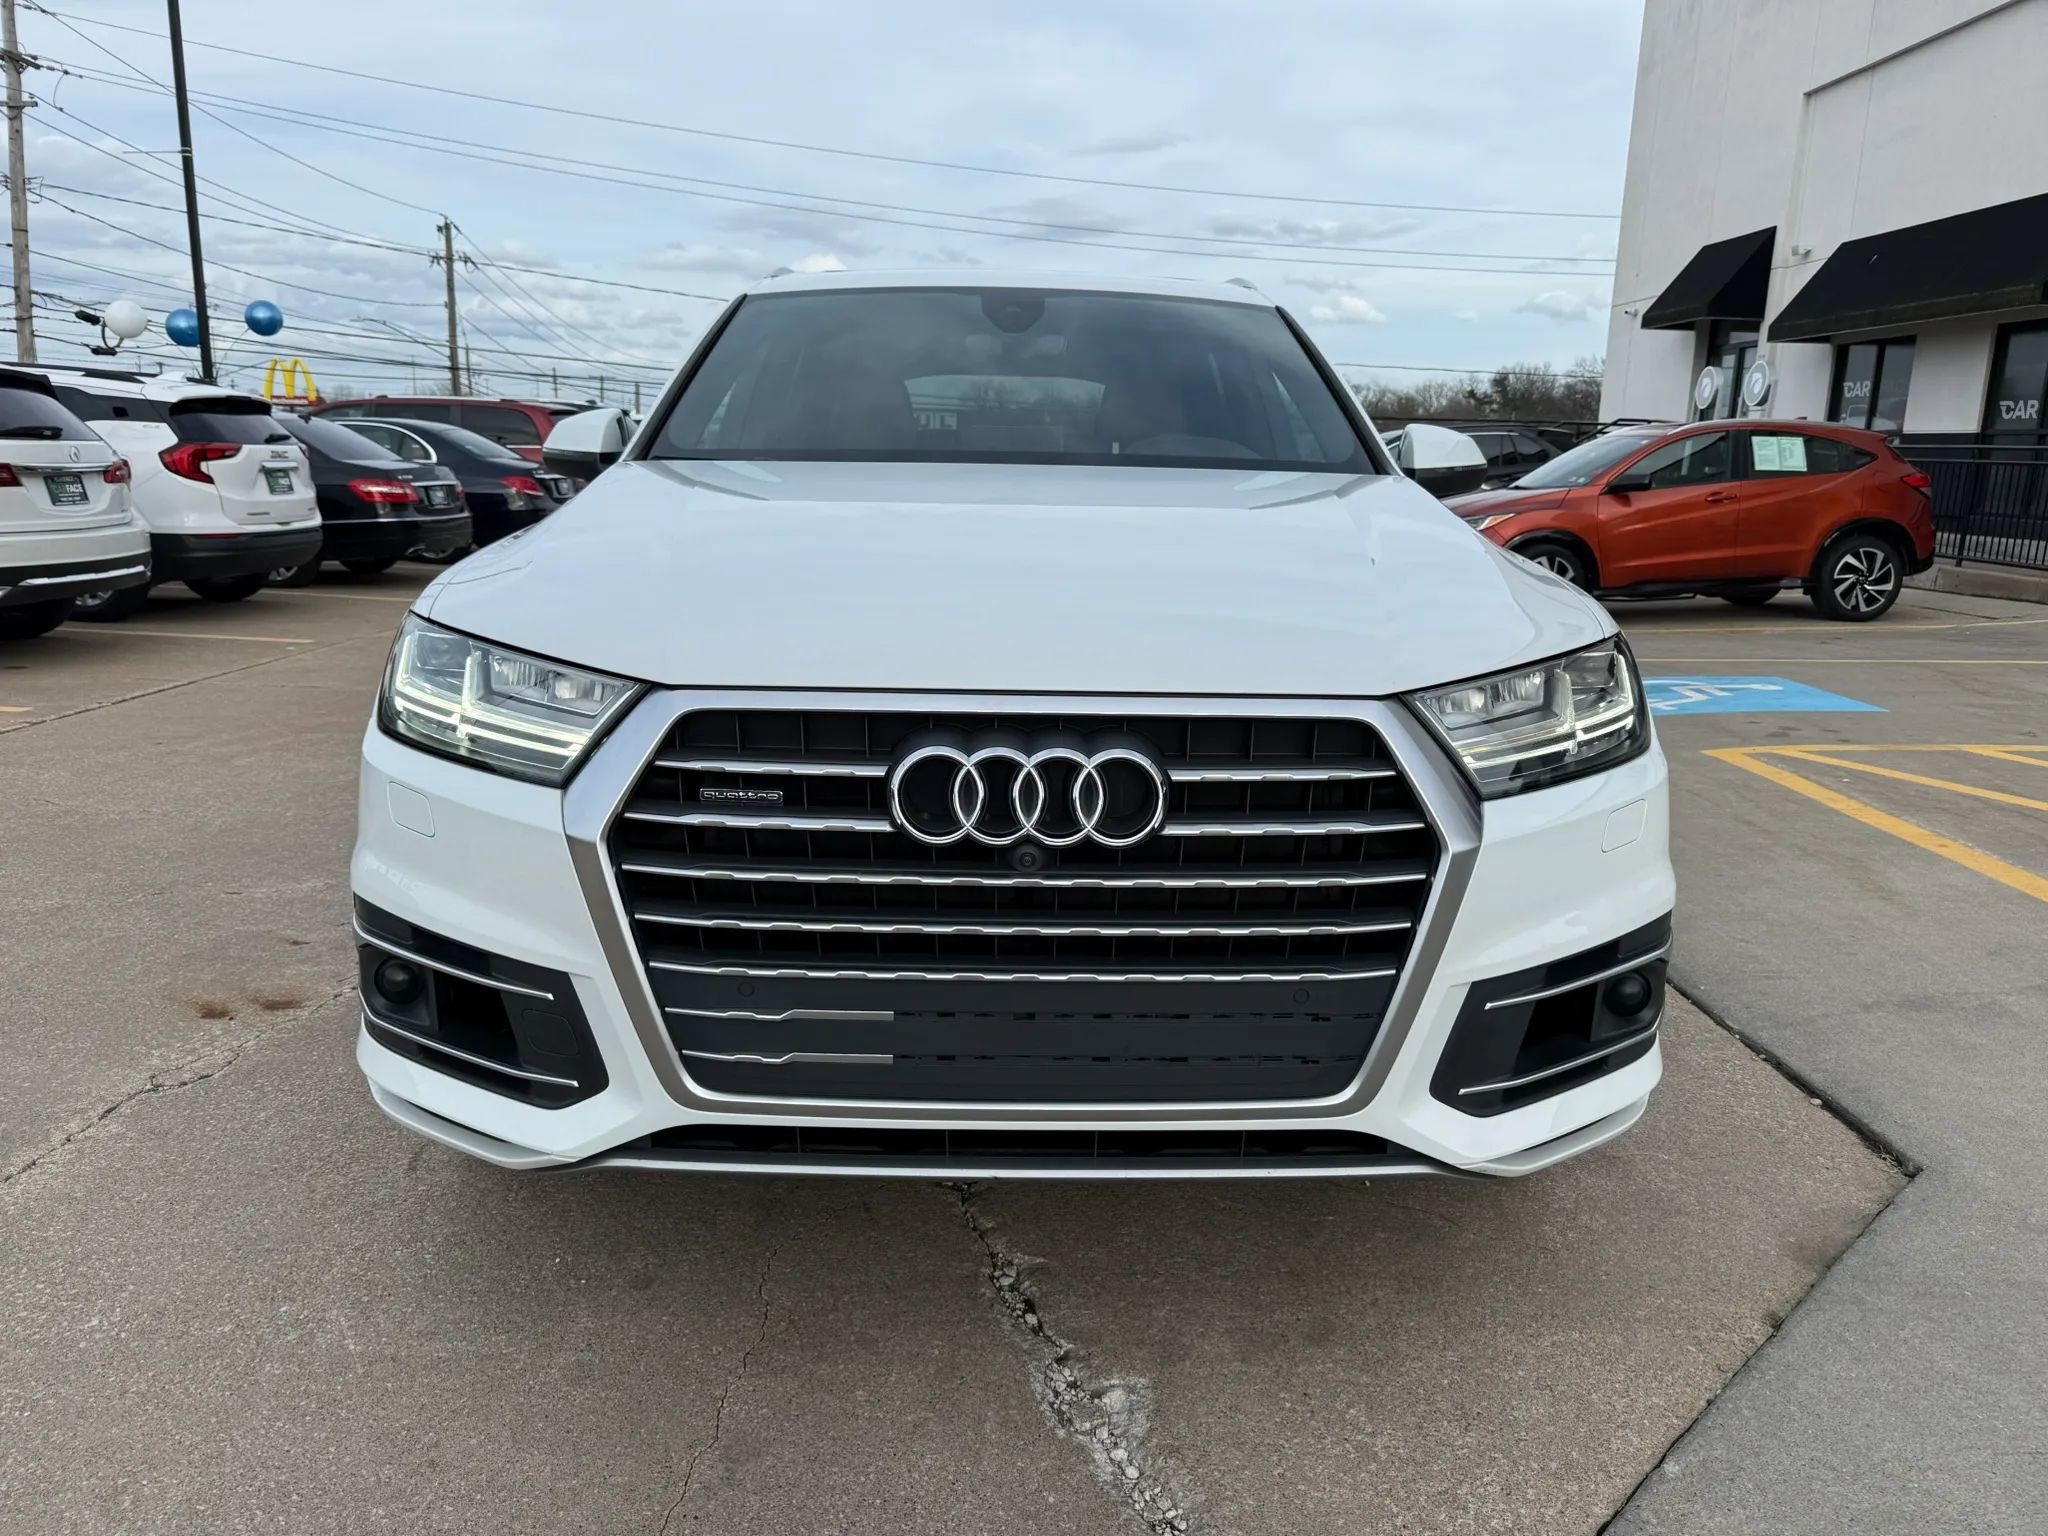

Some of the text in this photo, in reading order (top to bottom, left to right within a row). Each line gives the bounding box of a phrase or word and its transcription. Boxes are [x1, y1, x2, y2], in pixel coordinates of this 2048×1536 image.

[1843, 381, 1871, 398] CAR
[1999, 399, 2039, 420] CAR
[703, 791, 779, 800] quattro
